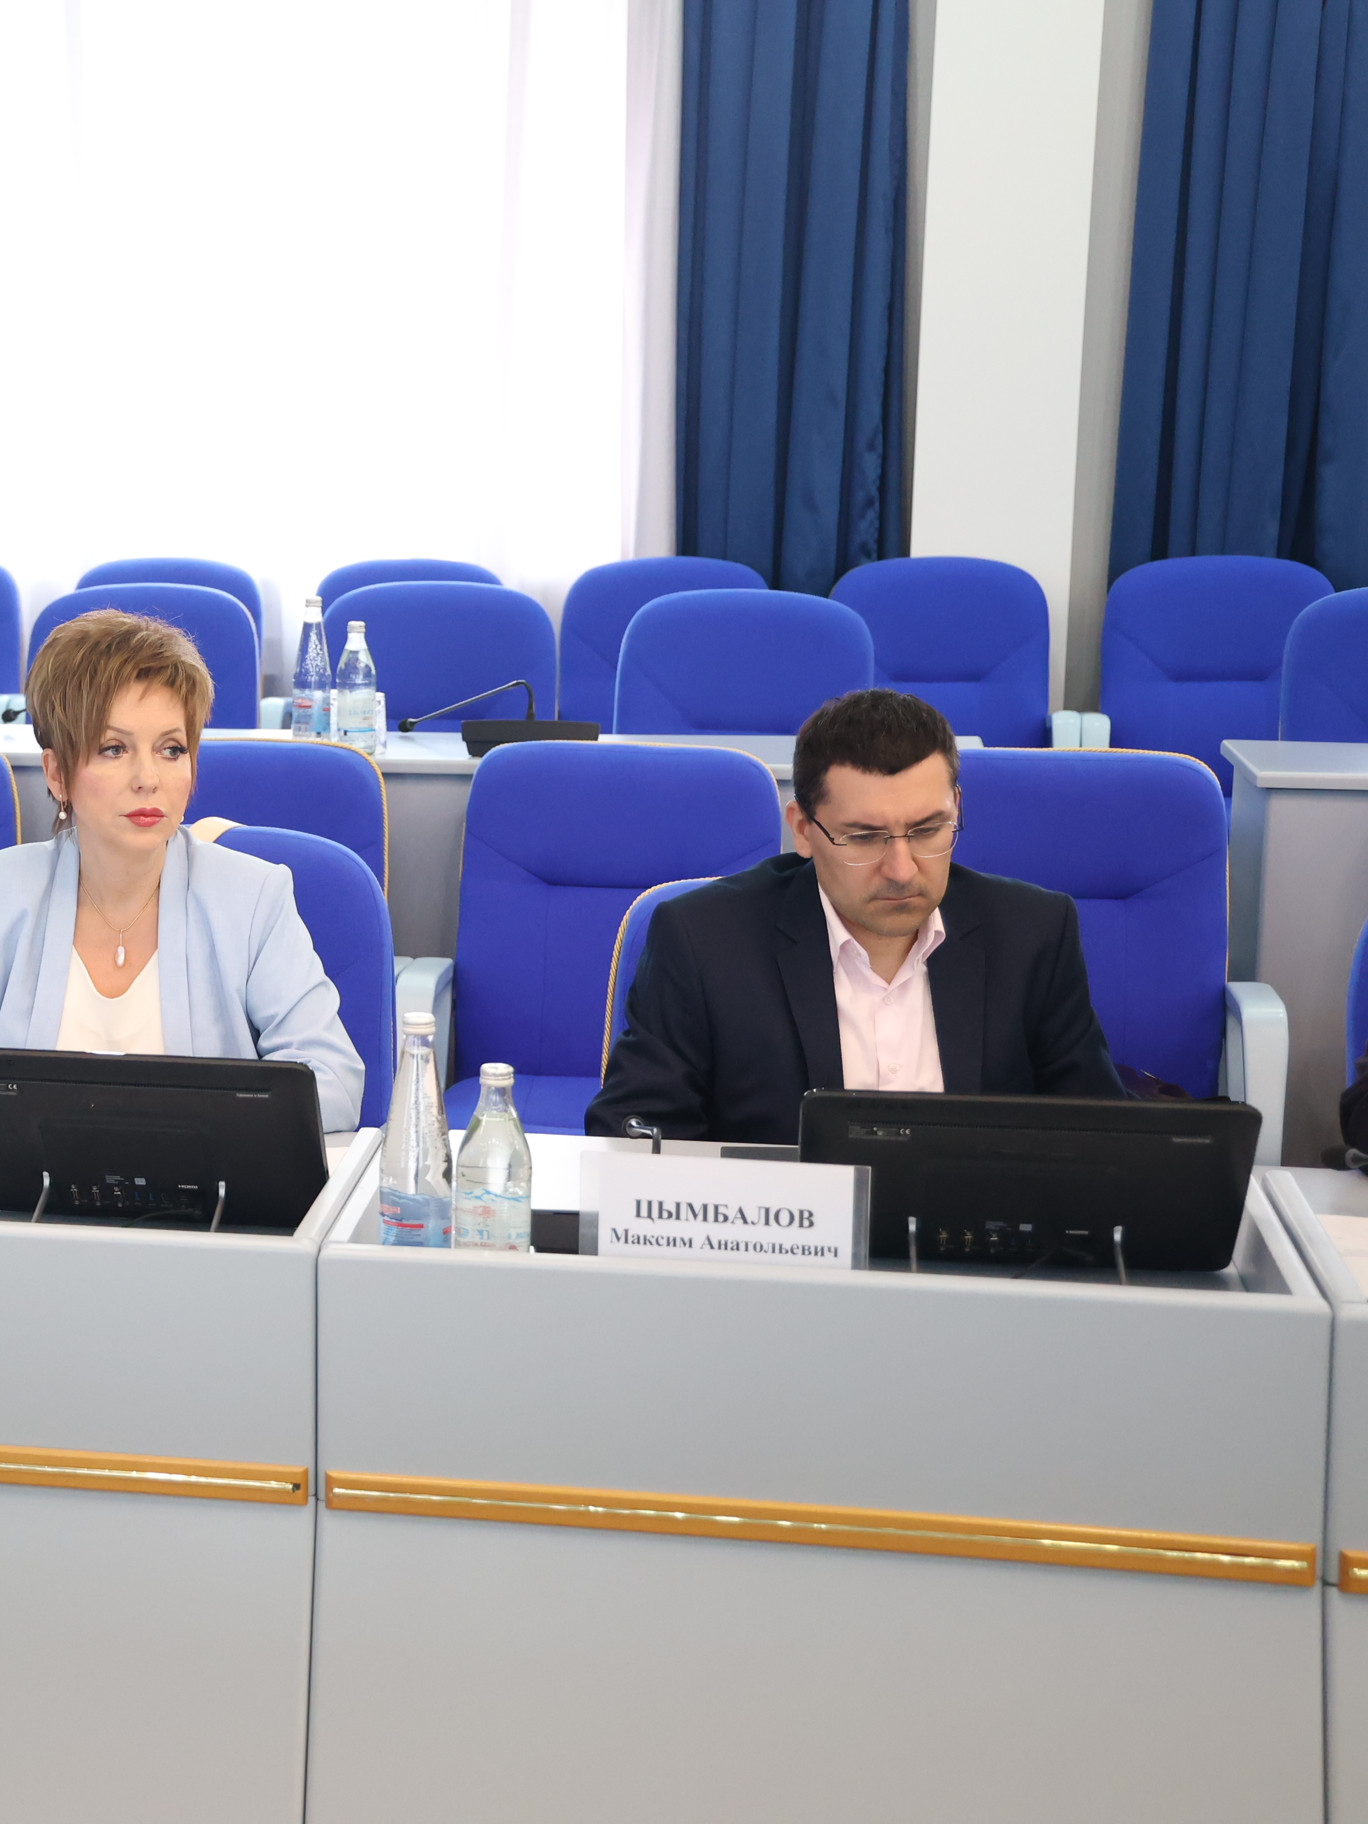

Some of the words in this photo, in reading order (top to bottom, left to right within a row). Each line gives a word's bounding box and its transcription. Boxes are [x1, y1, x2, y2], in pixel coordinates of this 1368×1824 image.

[634, 1198, 816, 1230] ЦЫМБАЛОВ
[609, 1227, 694, 1249] Максим
[699, 1233, 840, 1259] Анатольевич
